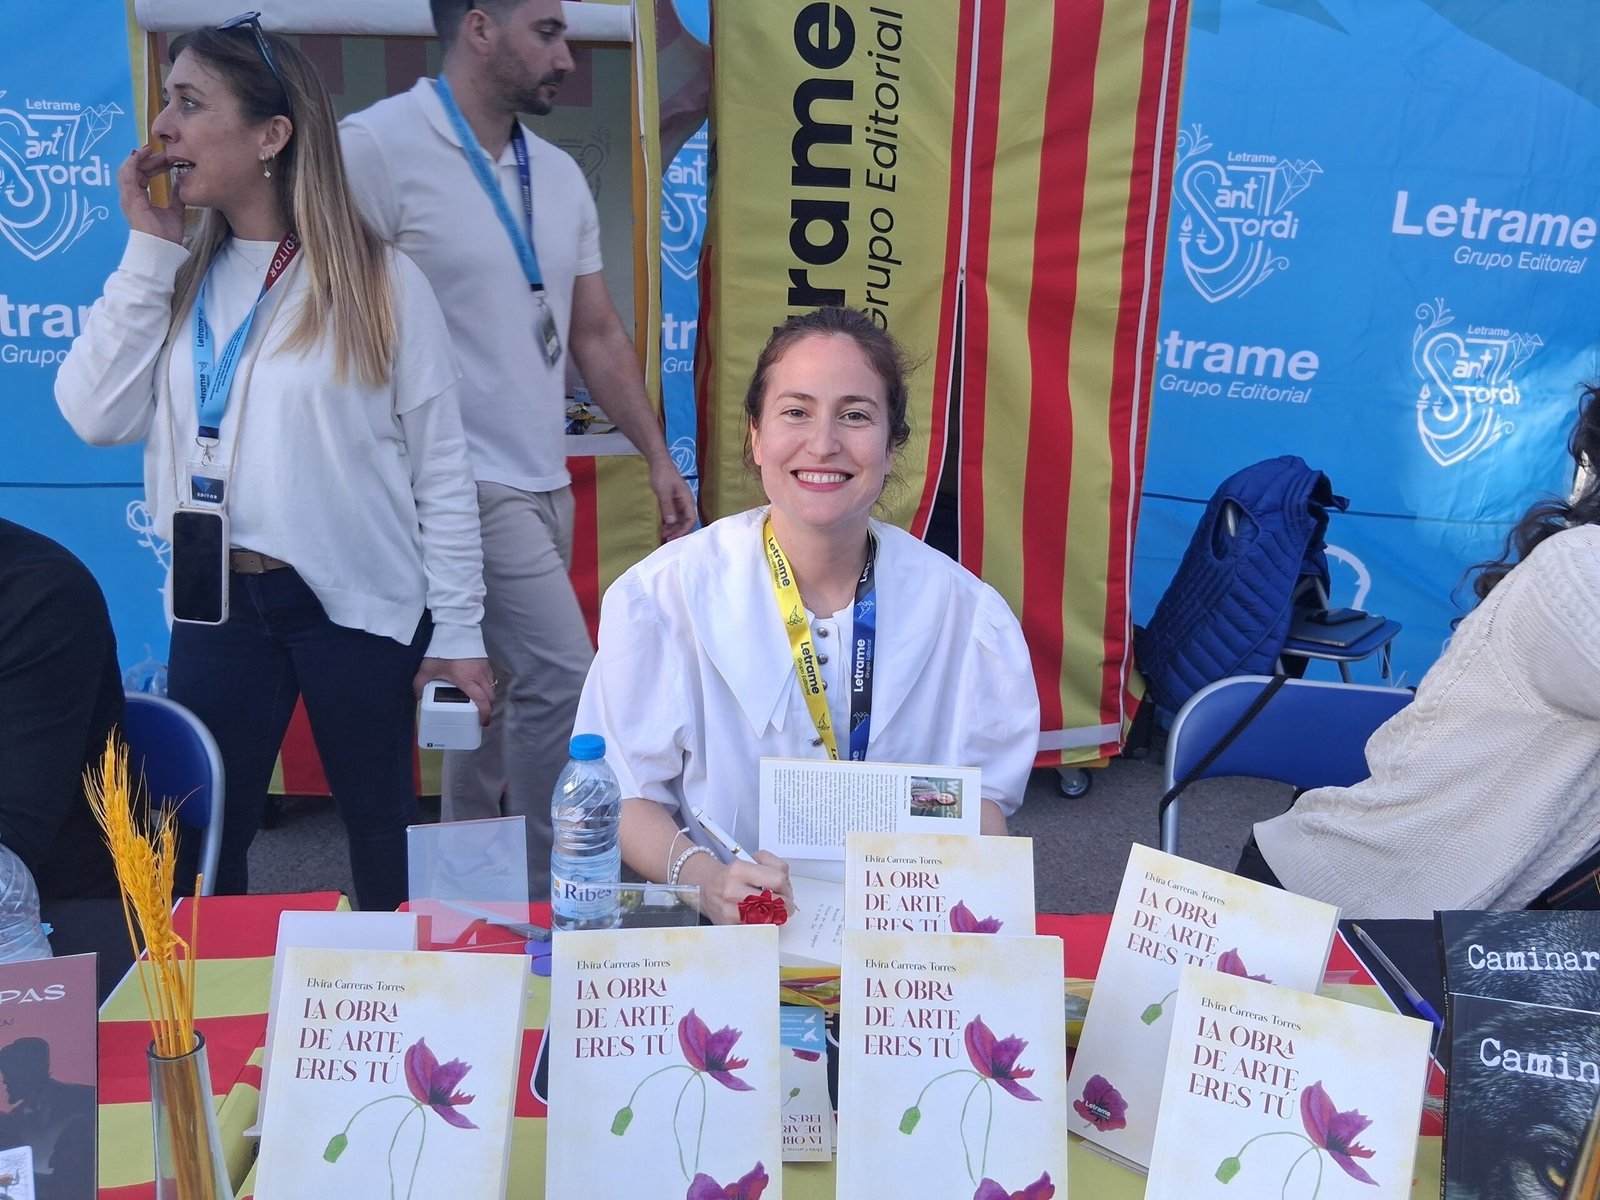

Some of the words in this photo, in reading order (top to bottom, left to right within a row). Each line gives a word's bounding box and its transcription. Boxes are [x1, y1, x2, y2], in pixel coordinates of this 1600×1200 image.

[26, 98, 81, 111] Letrame
[865, 7, 903, 193] Editorial
[774, 2, 856, 333] rame
[1227, 151, 1277, 163] Letrame
[1392, 190, 1597, 250] Letrame
[1454, 246, 1512, 270] Grupo
[1518, 251, 1587, 274] Editorial
[1467, 324, 1510, 337] Letrame
[1, 344, 69, 368] Grupo
[1156, 330, 1320, 381] trame
[1160, 374, 1222, 398] Grupo
[1227, 381, 1312, 403] Editorial
[768, 537, 791, 587] Letrame
[800, 641, 820, 694] Letrame
[854, 639, 866, 692] Letrame
[865, 854, 885, 863] Elvira
[886, 855, 917, 864] Carreras
[919, 856, 942, 865] Torres
[565, 883, 612, 902] Ribes
[866, 870, 885, 887] LA
[890, 871, 940, 889] OBRA
[1145, 871, 1166, 885] Elvira
[1167, 880, 1199, 897] Carreras
[1201, 890, 1225, 905] Torres
[865, 894, 891, 911] DE
[896, 895, 947, 913] ARTE
[1139, 887, 1158, 909] LA
[1165, 897, 1217, 929] OBRA
[865, 917, 914, 932] ERES
[1133, 910, 1161, 934] DE
[1164, 923, 1220, 955] ARTE
[1127, 932, 1178, 966] ERES
[1468, 944, 1600, 971] Caminar
[577, 960, 602, 970] Elvira
[603, 959, 640, 970] Carreras
[643, 958, 671, 968] Torres
[865, 959, 889, 969] Elvira
[891, 960, 927, 971] Carreras
[929, 962, 957, 972] Torres
[306, 977, 333, 989] Elvira
[335, 979, 373, 990] Carreras
[376, 981, 405, 992] Torres
[577, 979, 600, 1000] LA
[607, 977, 668, 999] OBRA
[866, 978, 888, 998] LA
[894, 979, 954, 1002] OBRA
[303, 998, 327, 1019] LA
[335, 999, 399, 1023] OBRA
[576, 1007, 608, 1029] DE
[614, 1005, 675, 1028] ARTE
[865, 1006, 895, 1027] DE
[901, 1008, 961, 1030] ARTE
[1201, 997, 1227, 1012] Elvira
[1229, 1004, 1268, 1022] Carreras
[1271, 1014, 1302, 1031] Torres
[299, 1027, 333, 1050] DE
[338, 1030, 403, 1053] ARTE
[575, 1035, 635, 1058] ERES
[641, 1027, 674, 1056] TÚ
[864, 1034, 922, 1057] ERES
[928, 1031, 960, 1059] TÚ
[1197, 1016, 1221, 1041] LA
[1230, 1025, 1295, 1060] OBRA
[295, 1057, 357, 1082] ERES
[365, 1055, 400, 1084] TÚ
[1193, 1044, 1227, 1072] DE
[1232, 1057, 1299, 1091] ARTE
[1480, 1038, 1599, 1085] Camin
[1189, 1072, 1252, 1108] ERES
[1260, 1091, 1295, 1120] TÚ
[789, 1114, 821, 1122] ERES
[805, 1125, 821, 1133] DE
[810, 1136, 821, 1144] LA
